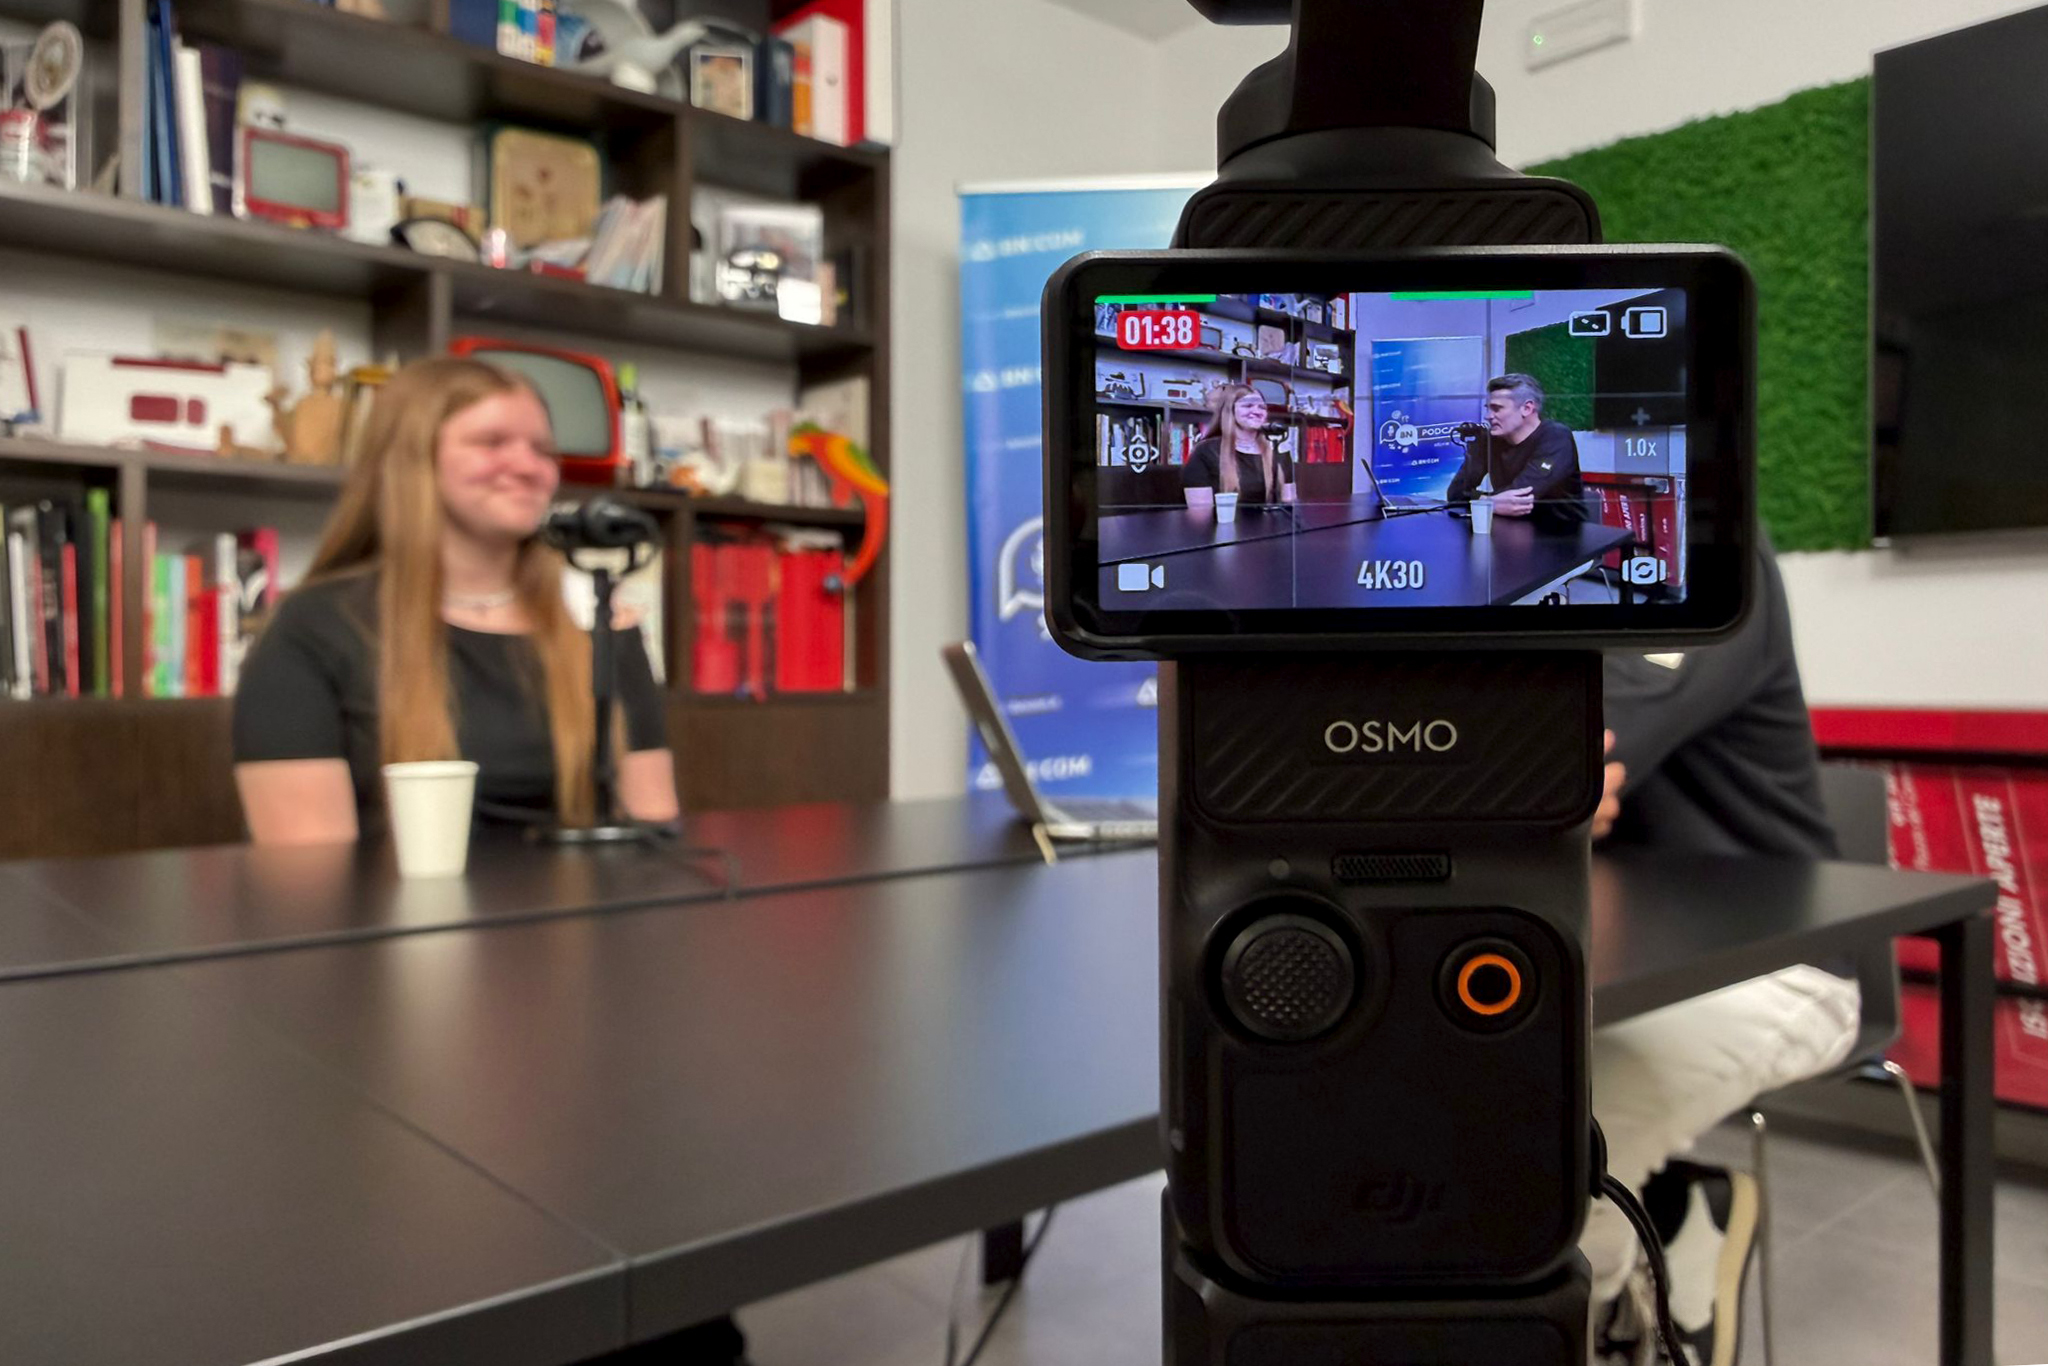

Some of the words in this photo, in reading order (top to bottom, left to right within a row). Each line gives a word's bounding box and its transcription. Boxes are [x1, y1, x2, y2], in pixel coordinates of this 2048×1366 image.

[1125, 315, 1193, 345] 01:38
[1625, 438, 1657, 457] 1.0x
[1357, 560, 1424, 590] 4K30
[1324, 719, 1458, 753] OSMO
[1972, 792, 2019, 894] APERTE
